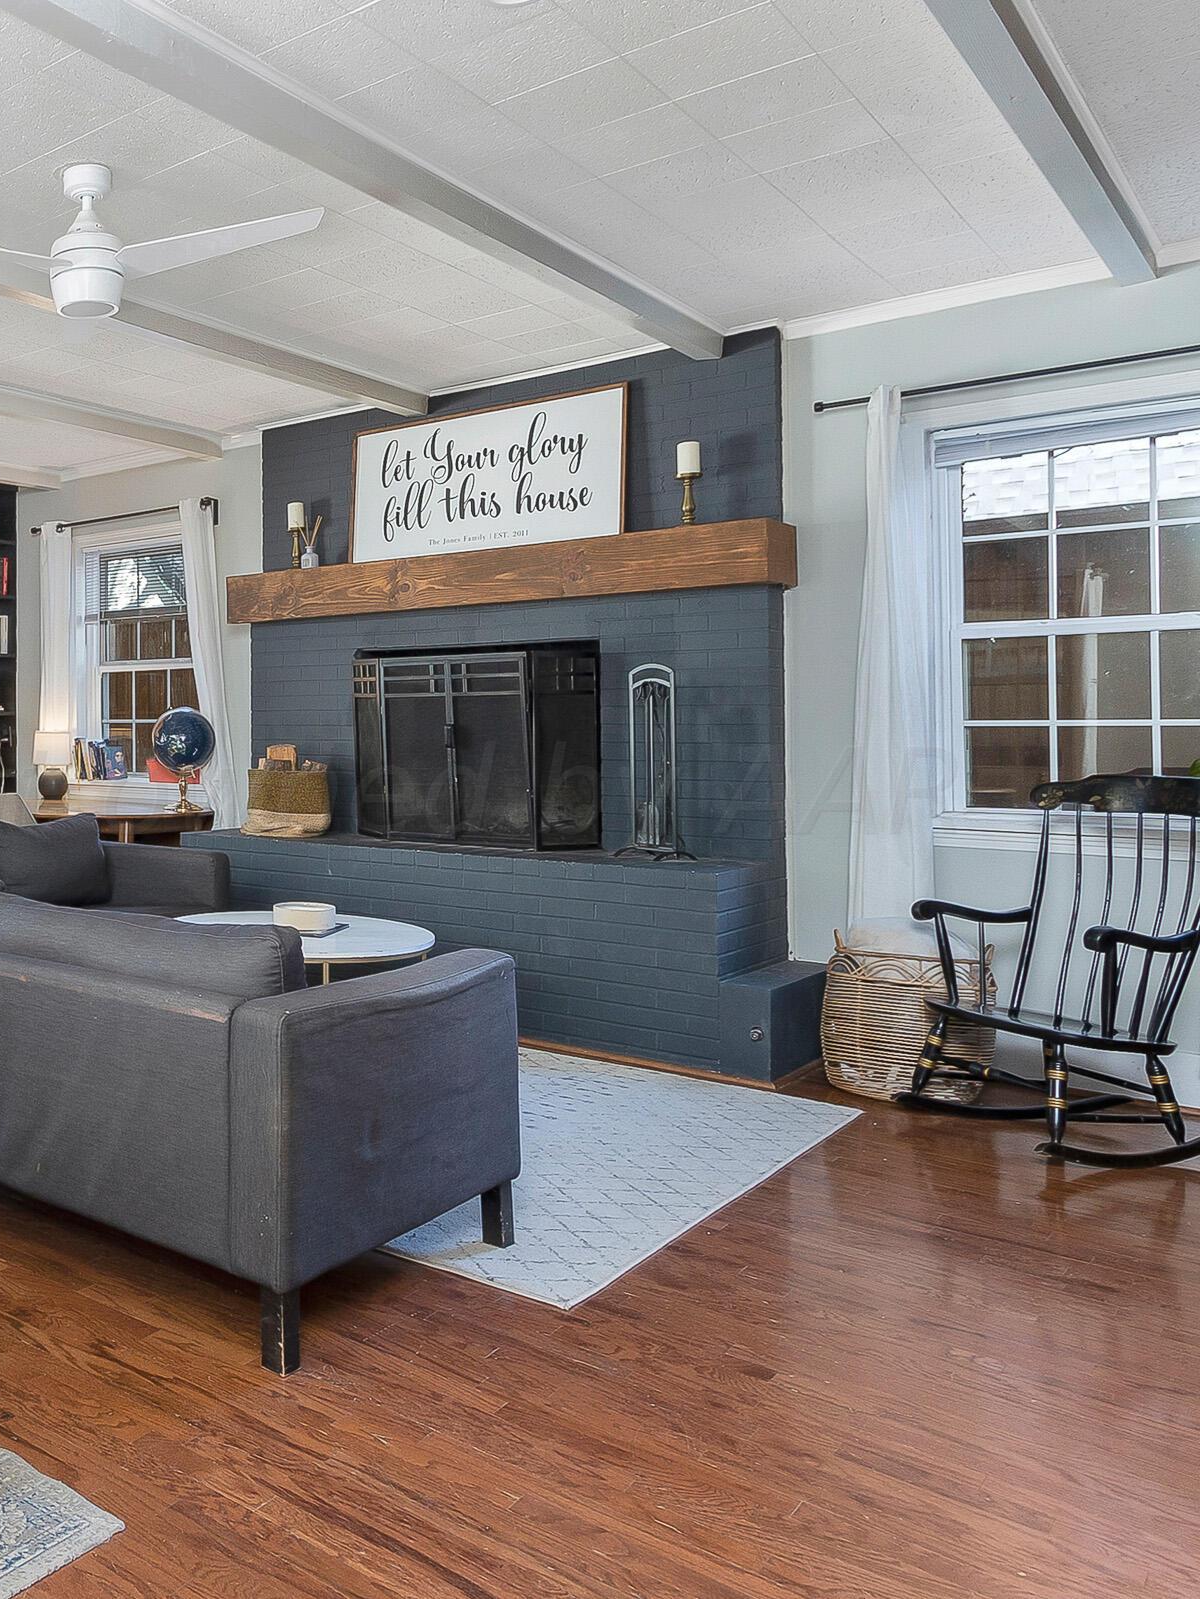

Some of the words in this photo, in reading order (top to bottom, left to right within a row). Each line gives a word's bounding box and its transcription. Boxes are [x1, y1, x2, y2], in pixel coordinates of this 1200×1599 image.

[382, 439, 416, 488] let
[423, 428, 500, 485] Your
[508, 411, 589, 482] glory
[383, 478, 434, 542] fill
[437, 472, 502, 524] this
[514, 472, 594, 515] house
[463, 534, 486, 542] Family
